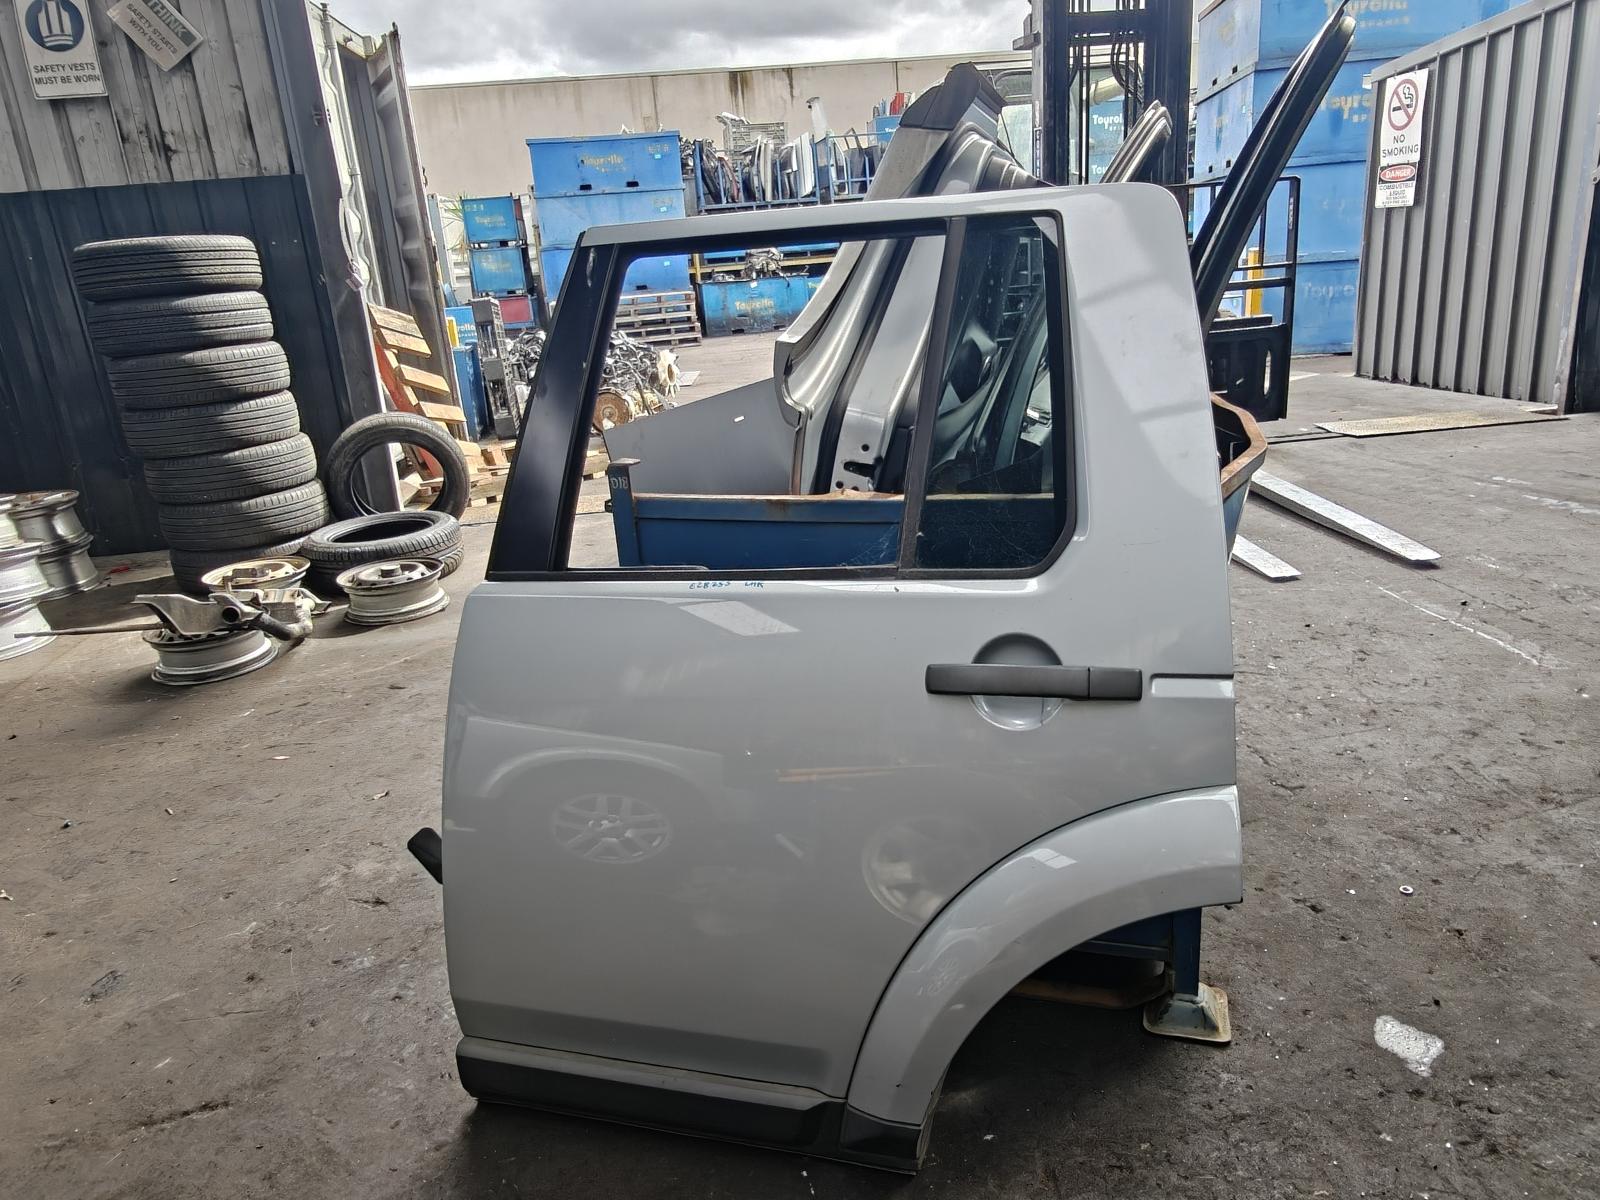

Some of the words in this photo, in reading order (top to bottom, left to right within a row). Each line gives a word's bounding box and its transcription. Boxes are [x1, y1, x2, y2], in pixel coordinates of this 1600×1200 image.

[148, 0, 187, 38] THINK
[127, 3, 152, 29] SAFETY
[151, 28, 177, 54] STARTS
[128, 18, 147, 37] WITH
[148, 35, 162, 51] YOU
[33, 64, 66, 74] SAFETY
[67, 62, 95, 72] VESTS
[34, 76, 58, 85] MUST
[60, 75, 72, 84] BE
[73, 74, 100, 83] WORN
[1393, 134, 1406, 144] NO
[1382, 144, 1419, 158] SMOKING
[1385, 167, 1412, 179] DANGER
